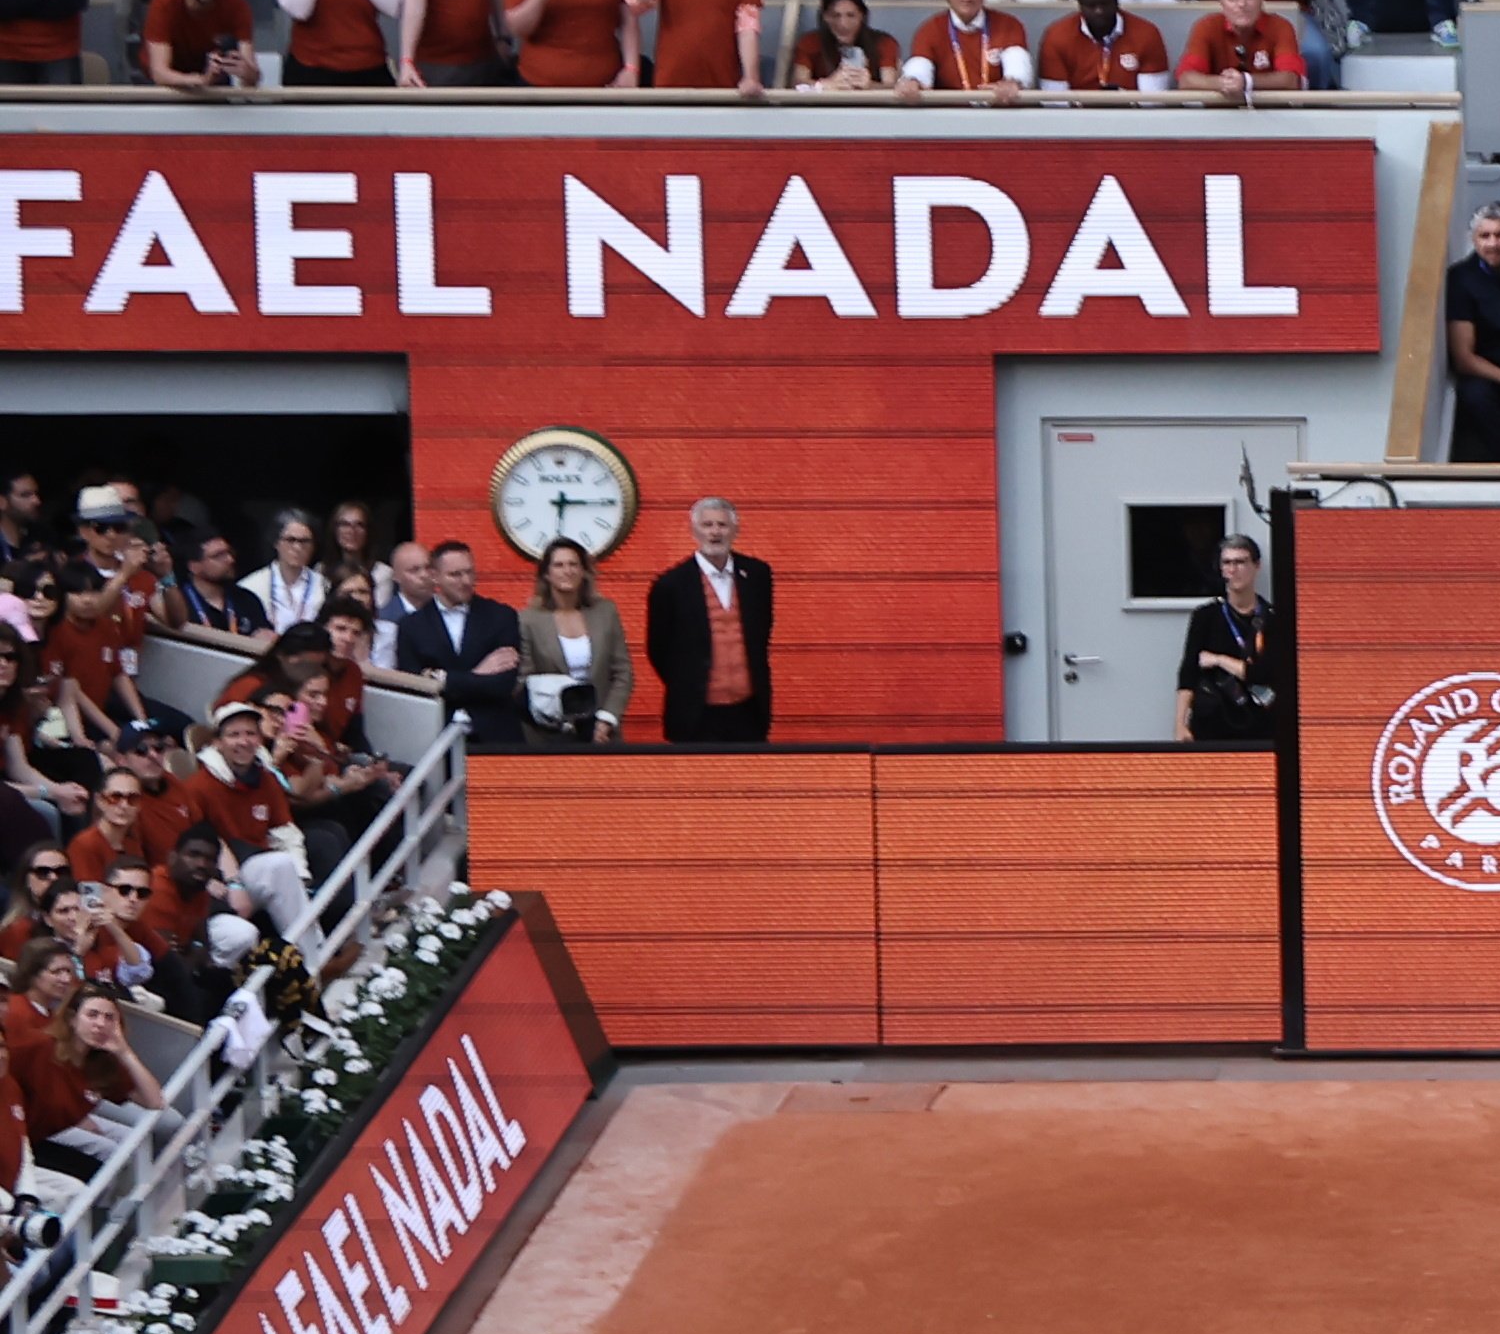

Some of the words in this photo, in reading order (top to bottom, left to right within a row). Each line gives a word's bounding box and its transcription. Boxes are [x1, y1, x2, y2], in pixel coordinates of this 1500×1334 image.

[565, 174, 1299, 319] NADAL
[1388, 688, 1479, 805] ROLAND
[368, 1033, 526, 1290] NADAL
